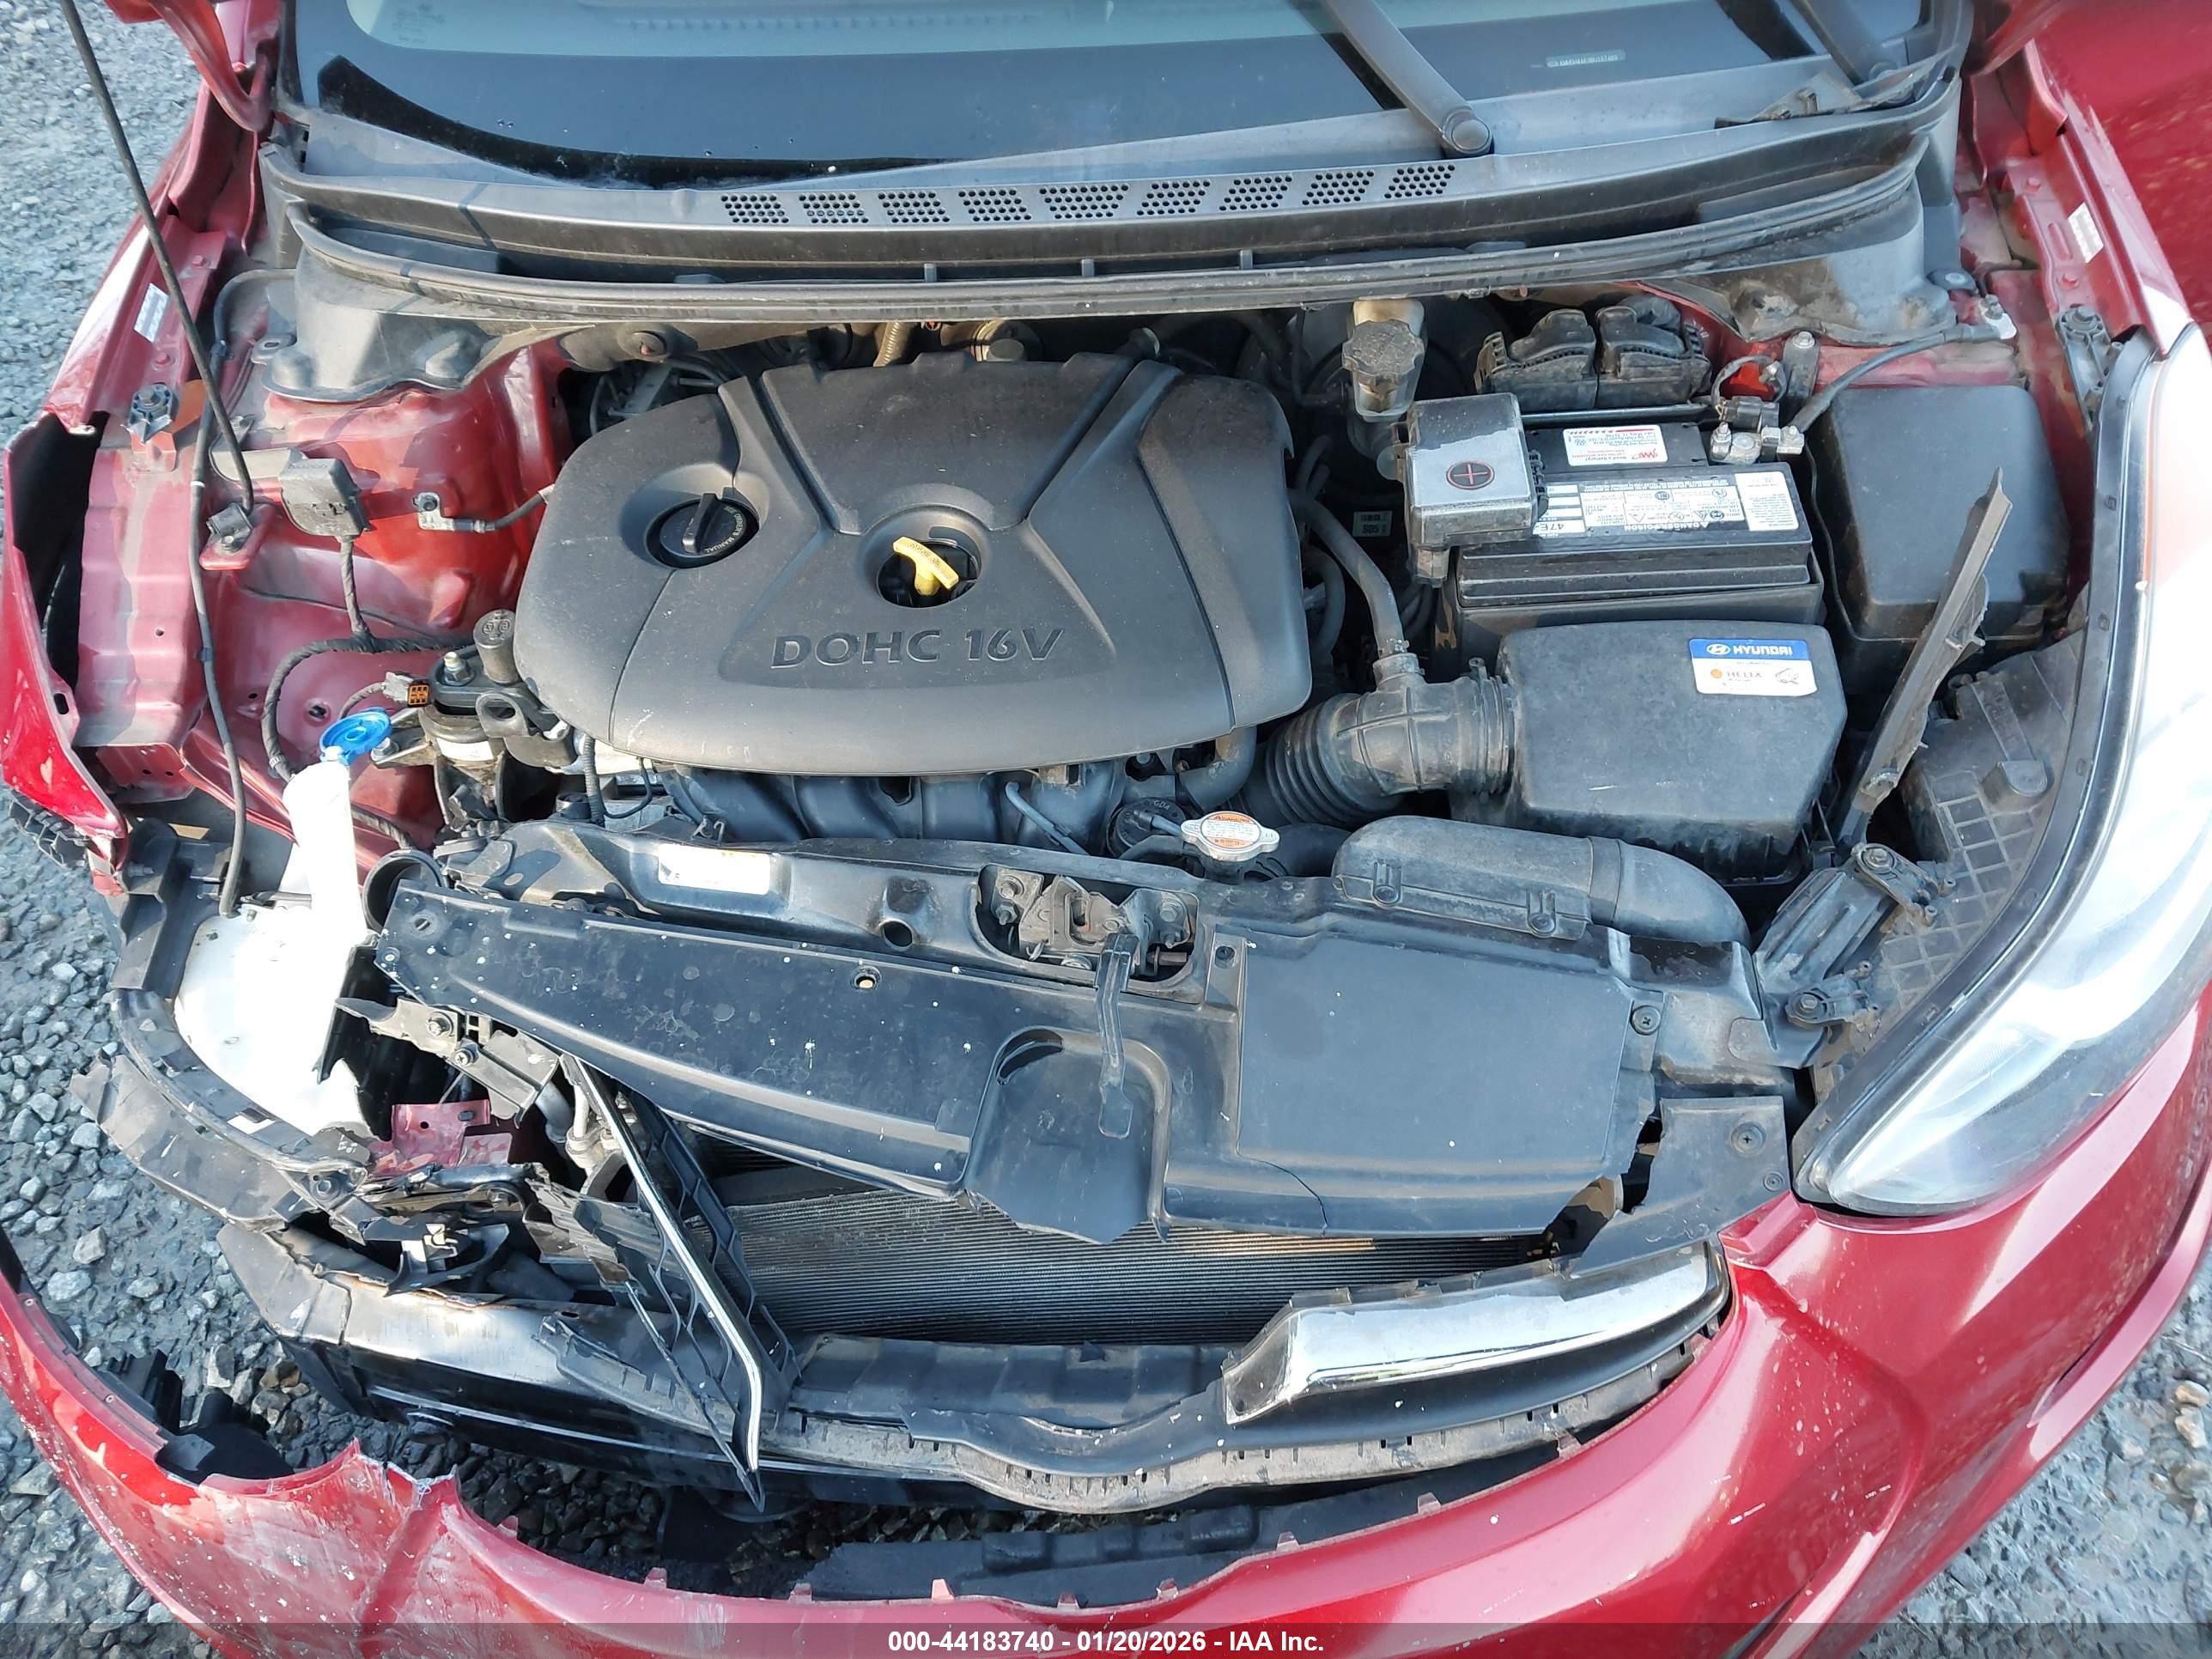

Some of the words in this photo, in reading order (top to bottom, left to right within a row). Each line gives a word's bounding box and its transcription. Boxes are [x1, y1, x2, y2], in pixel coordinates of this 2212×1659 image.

[771, 629, 941, 669] DOHC
[964, 628, 1065, 662] 16V
[1733, 646, 1793, 656] HYUNDAI
[1153, 799, 1170, 811] GDA
